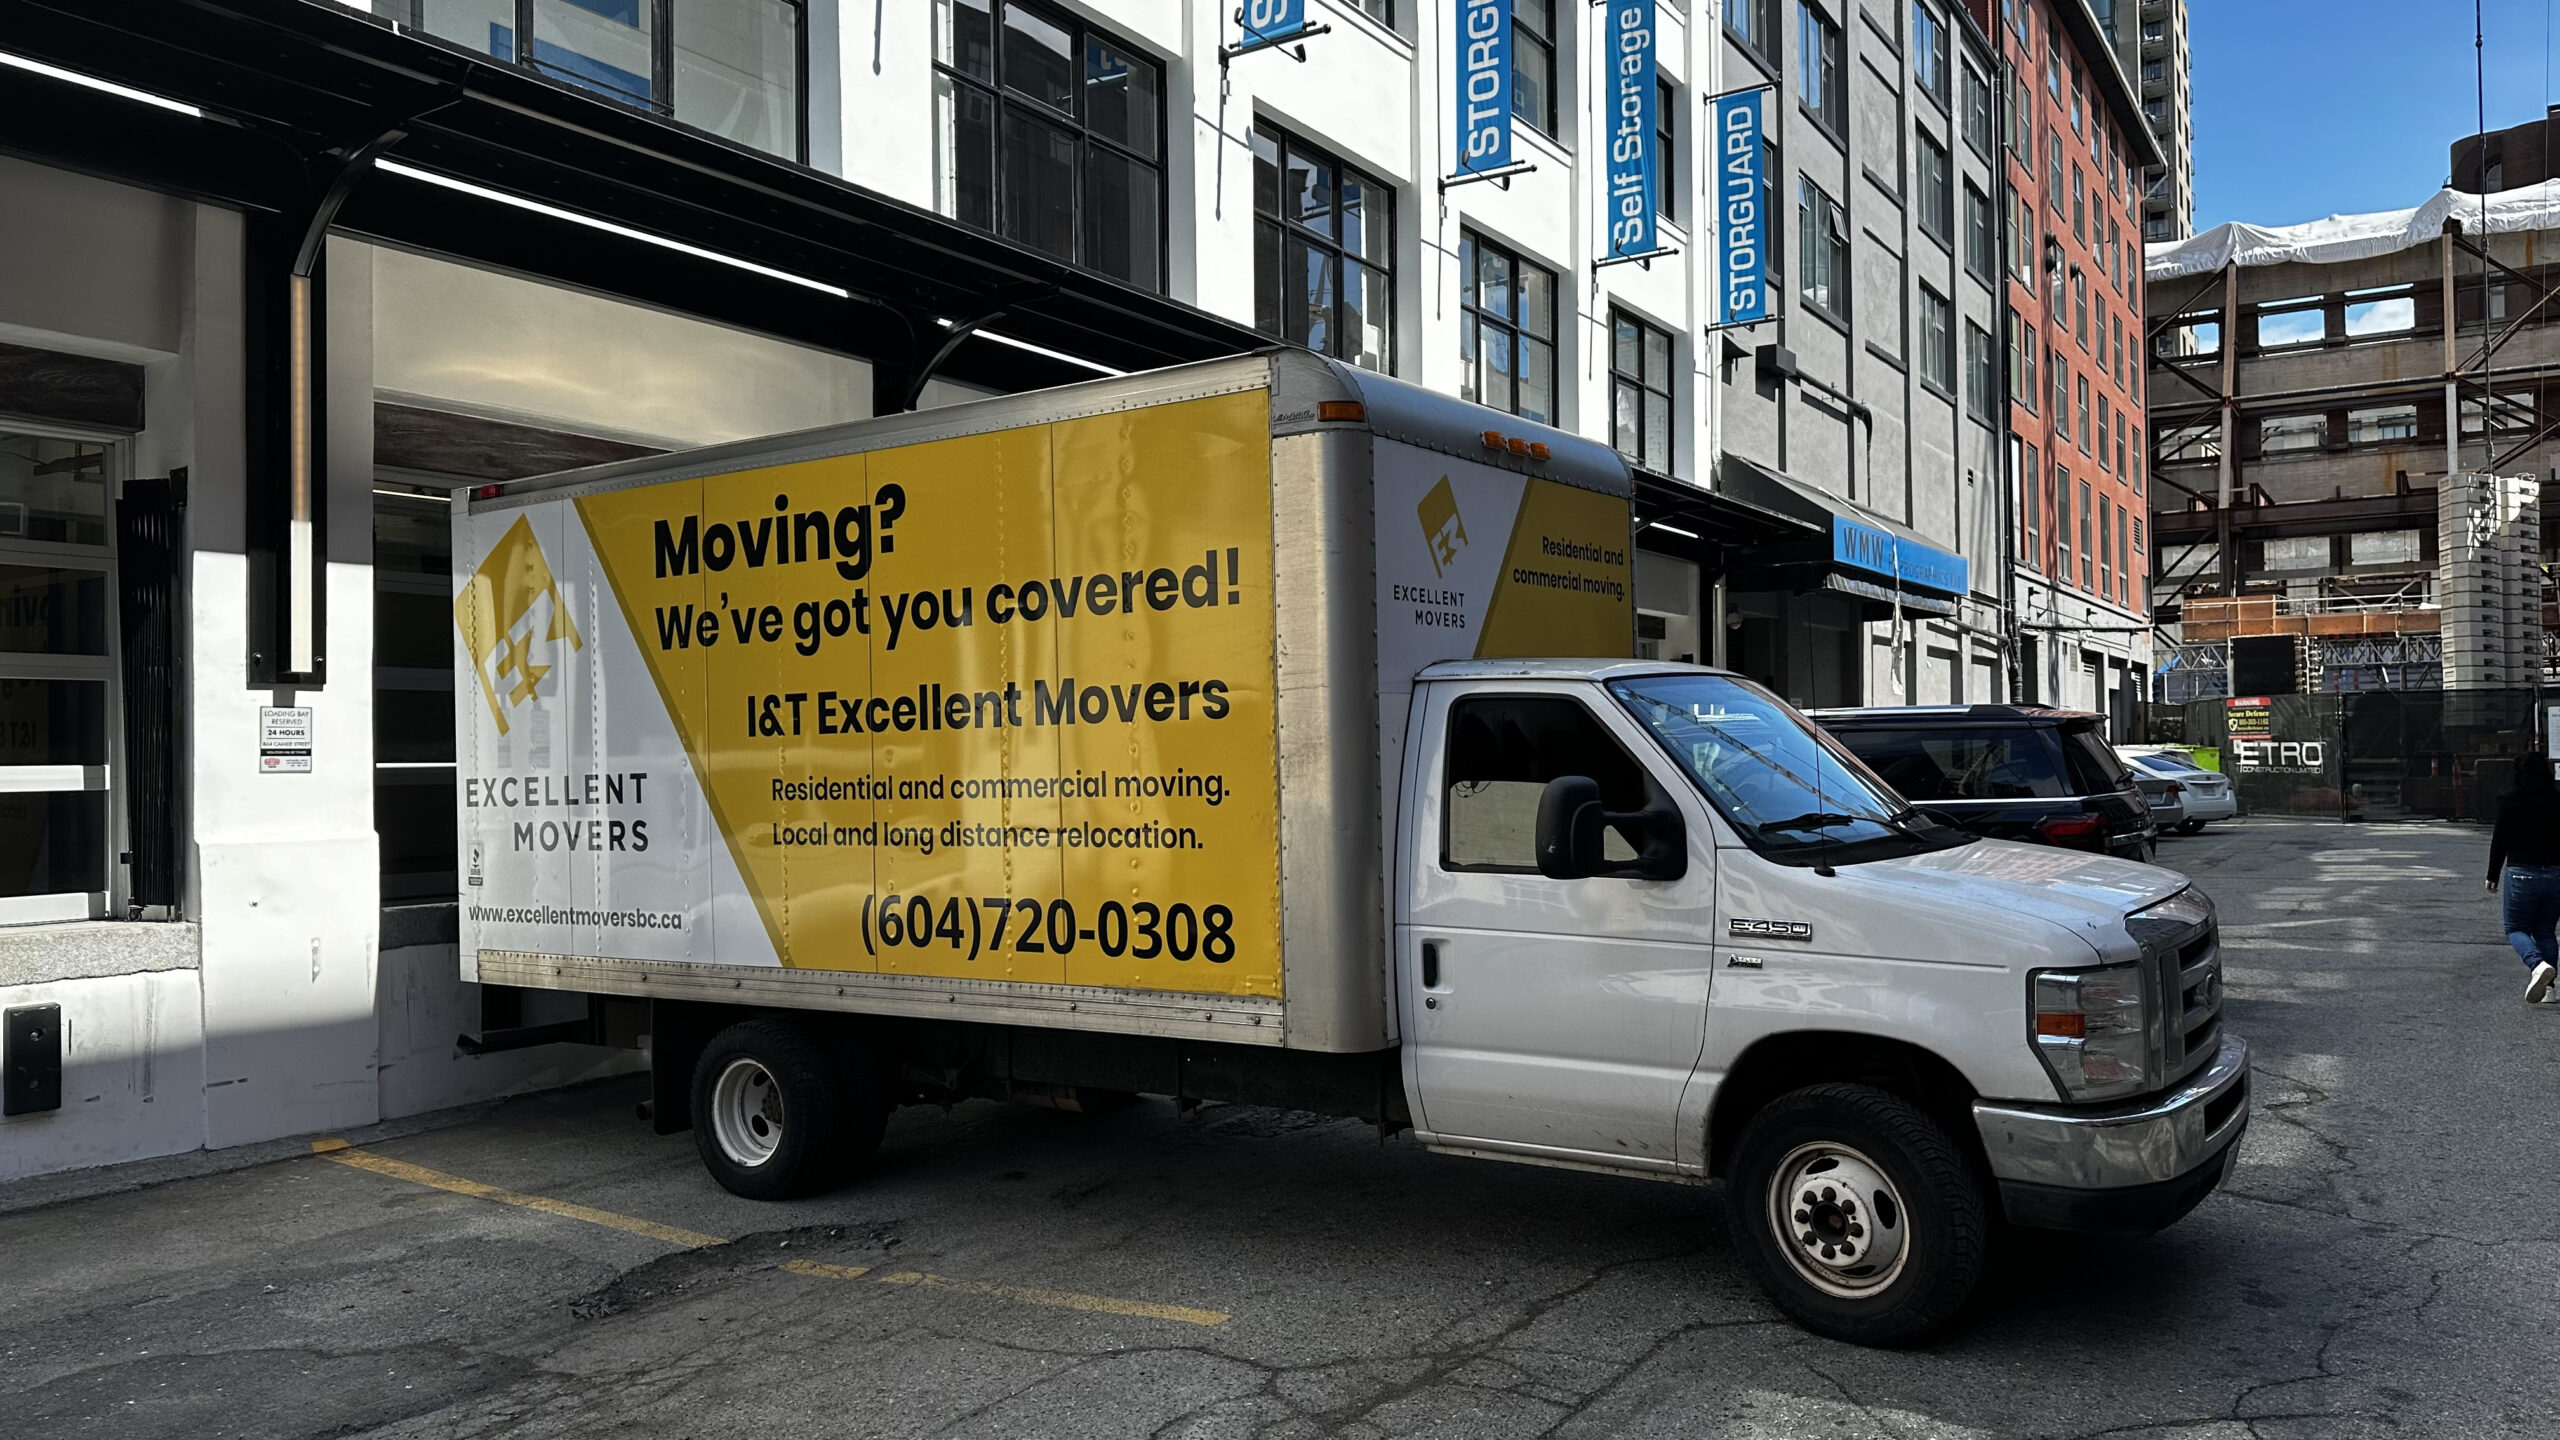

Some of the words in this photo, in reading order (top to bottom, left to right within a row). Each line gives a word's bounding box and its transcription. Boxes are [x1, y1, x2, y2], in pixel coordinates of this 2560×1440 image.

[1467, 0, 1500, 158] STORG
[1613, 6, 1650, 160] Storage
[1613, 172, 1643, 244] Self
[1727, 105, 1756, 310] STORGUARD
[654, 483, 906, 581] Moving?
[1542, 536, 1602, 563] Residential
[1604, 548, 1624, 566] and
[1843, 527, 1884, 568] WMW
[793, 588, 871, 657] got
[880, 587, 973, 651] you
[986, 547, 1240, 624] covered!
[1393, 584, 1465, 607] EXCELLENT
[1513, 568, 1581, 591] commercial
[1583, 577, 1625, 602] moving.
[1415, 610, 1466, 629] MOVERS
[748, 692, 808, 737] I&T
[817, 681, 1022, 735] Excellent
[1034, 678, 1230, 726] Movers
[772, 774, 892, 801] Residential
[899, 774, 944, 800] and
[950, 769, 1106, 799] commercial
[1115, 767, 1230, 806] moving.
[2243, 766, 2295, 774] CONSTRUCTION
[466, 773, 647, 807] EXCELLENT
[514, 820, 649, 852] MOVERS
[772, 821, 828, 846] Local
[833, 821, 877, 846] and
[884, 821, 934, 855] long
[940, 820, 1049, 847] distance
[1056, 819, 1203, 849] relocation.
[469, 905, 682, 930] www.excellentmoversbc.ca
[861, 894, 1235, 963] (604)720-0308
